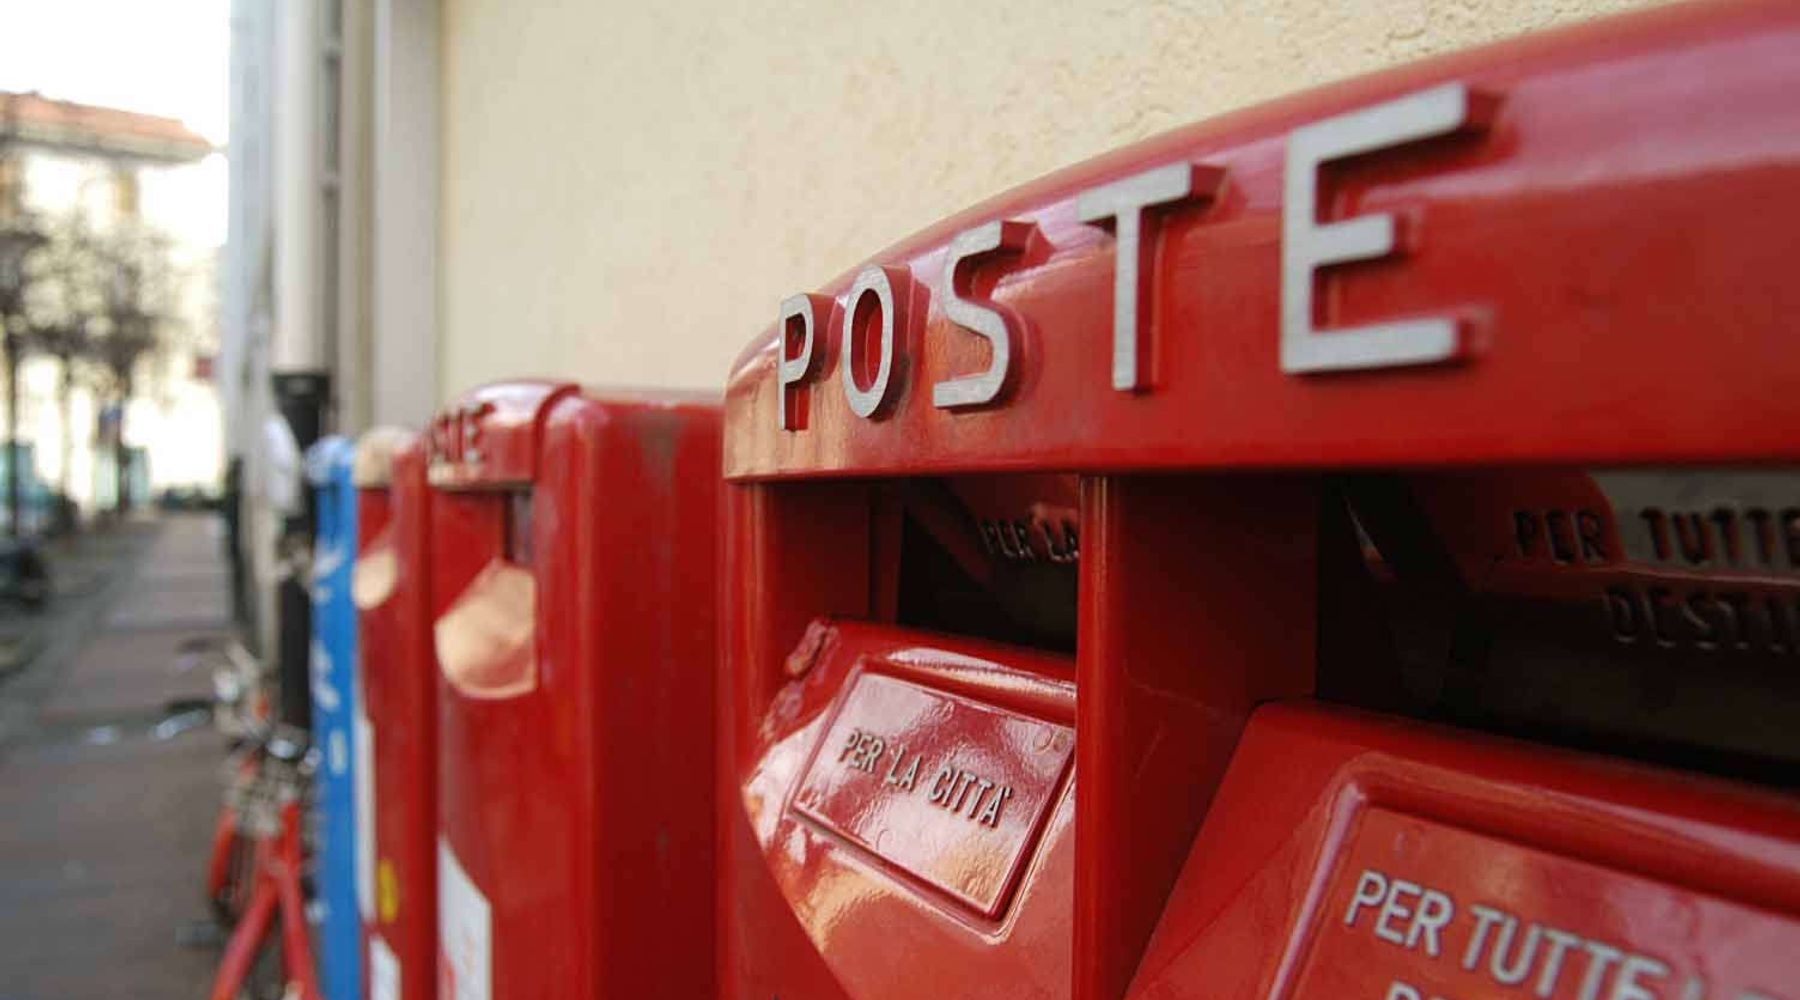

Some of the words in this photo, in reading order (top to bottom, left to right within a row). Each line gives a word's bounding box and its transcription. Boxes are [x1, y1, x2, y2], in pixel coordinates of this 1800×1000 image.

[777, 82, 1469, 432] POSTE
[1513, 509, 1605, 566] PER
[839, 730, 885, 773] PER
[887, 748, 924, 794] LA
[1344, 869, 1453, 956] PER
[1462, 906, 1669, 1000] TUTTE
